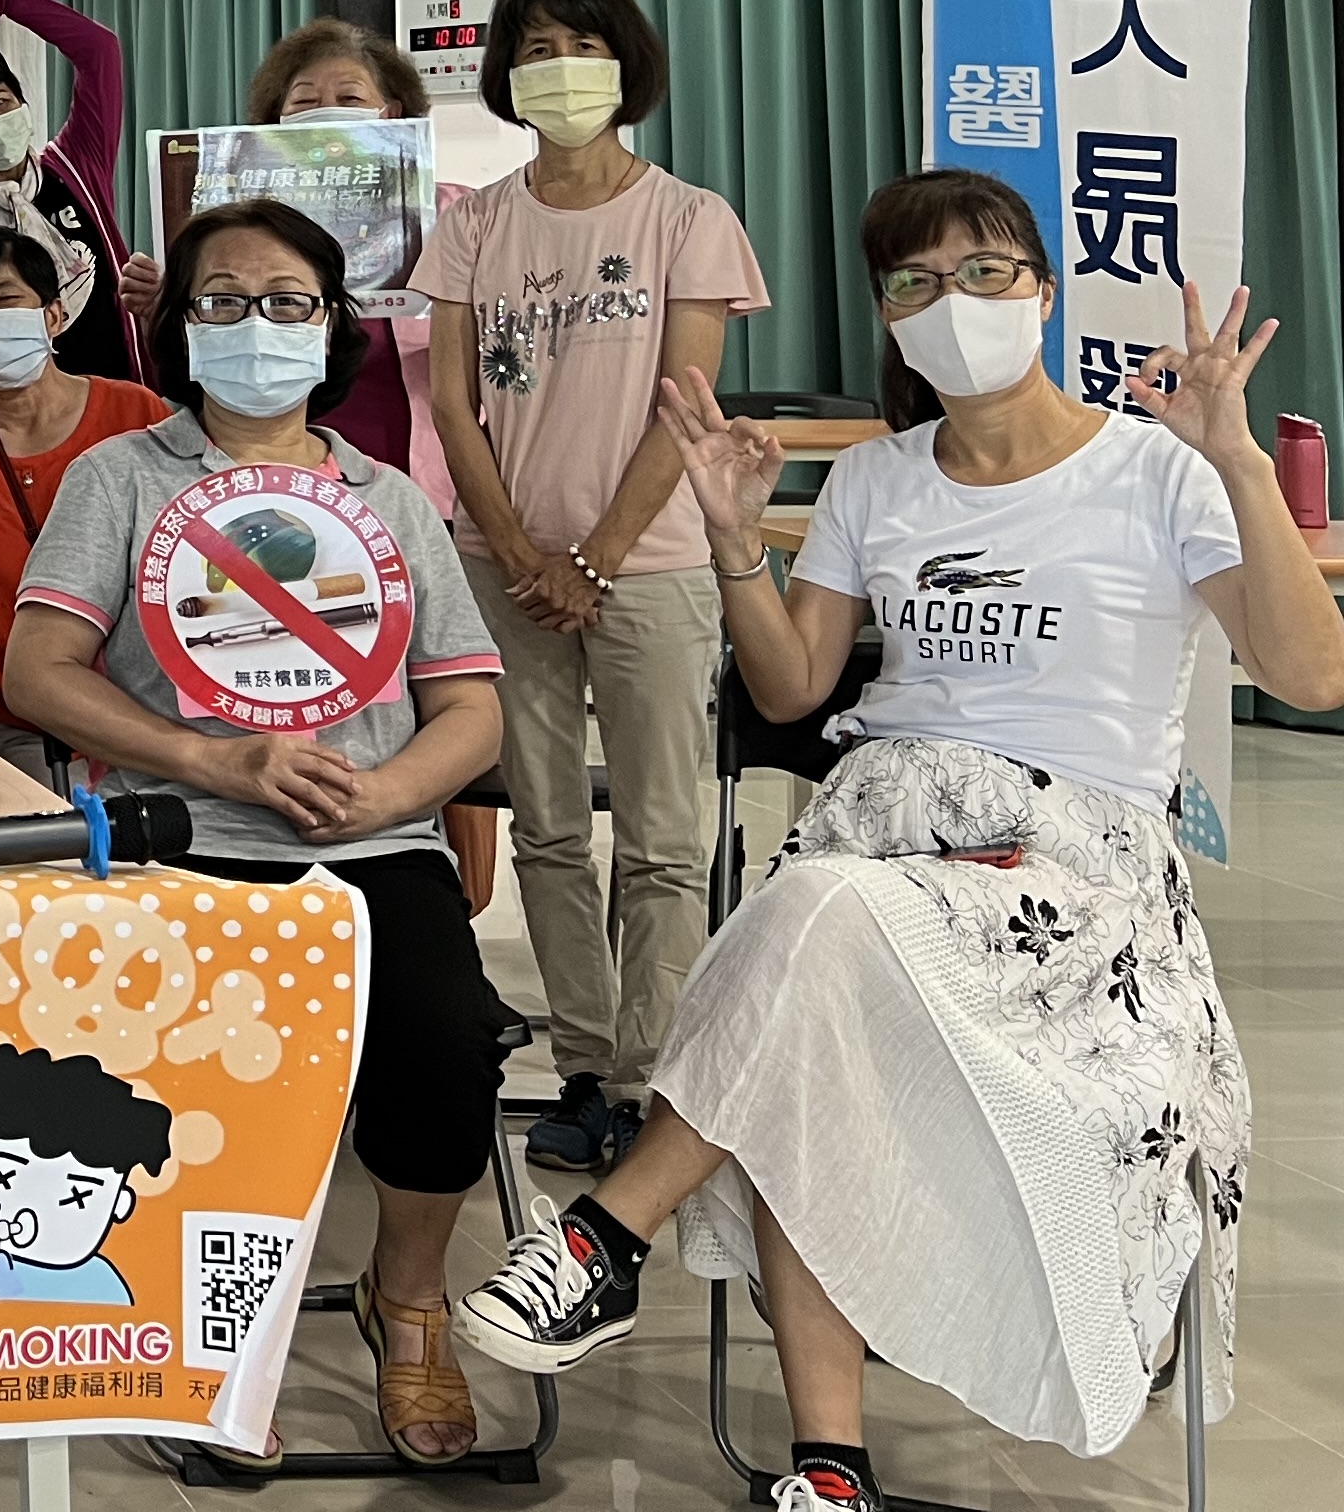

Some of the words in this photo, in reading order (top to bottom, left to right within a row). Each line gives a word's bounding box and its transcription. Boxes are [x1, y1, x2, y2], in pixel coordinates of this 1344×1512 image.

[523, 268, 564, 298] Always
[882, 596, 1062, 641] LACOSTE
[919, 638, 1015, 664] SPORT
[234, 668, 333, 688] 無菸檳醫院
[211, 691, 294, 727] 天晟醫院
[301, 688, 359, 726] 關心您
